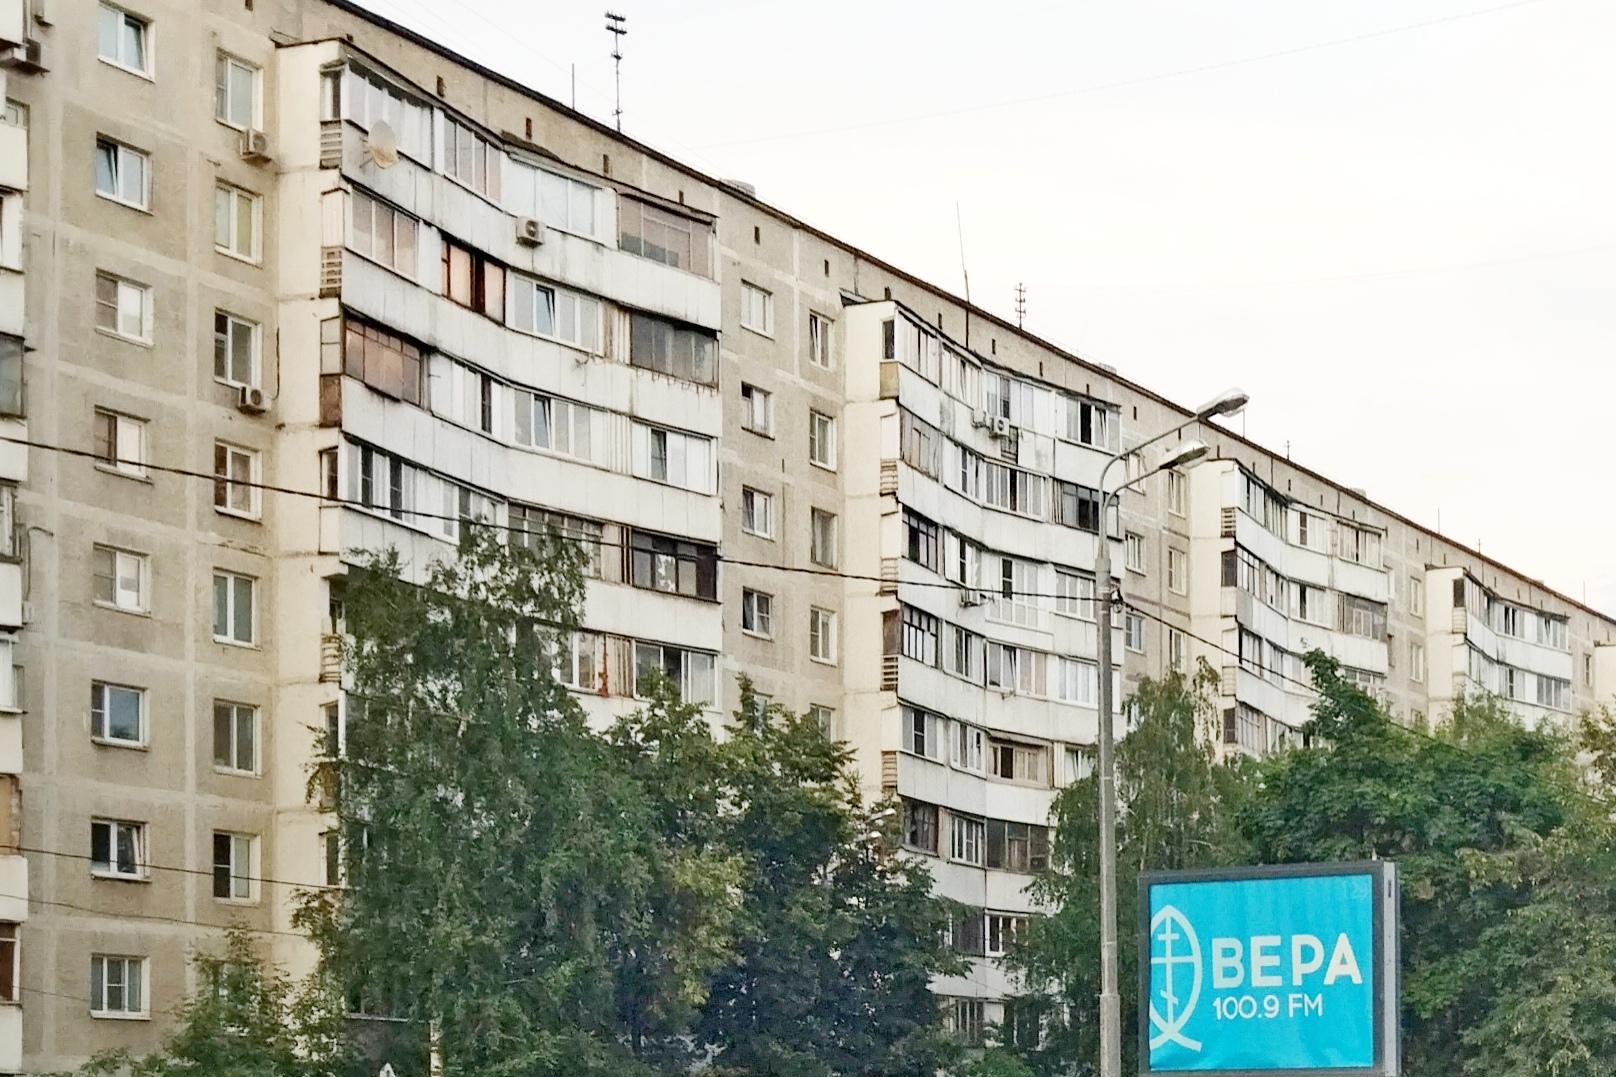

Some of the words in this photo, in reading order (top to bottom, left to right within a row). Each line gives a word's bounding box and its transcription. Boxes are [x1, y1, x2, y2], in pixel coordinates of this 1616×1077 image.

[1211, 933, 1363, 989] ВЕРА
[1212, 995, 1280, 1021] 100.9
[1288, 994, 1323, 1019] FM
